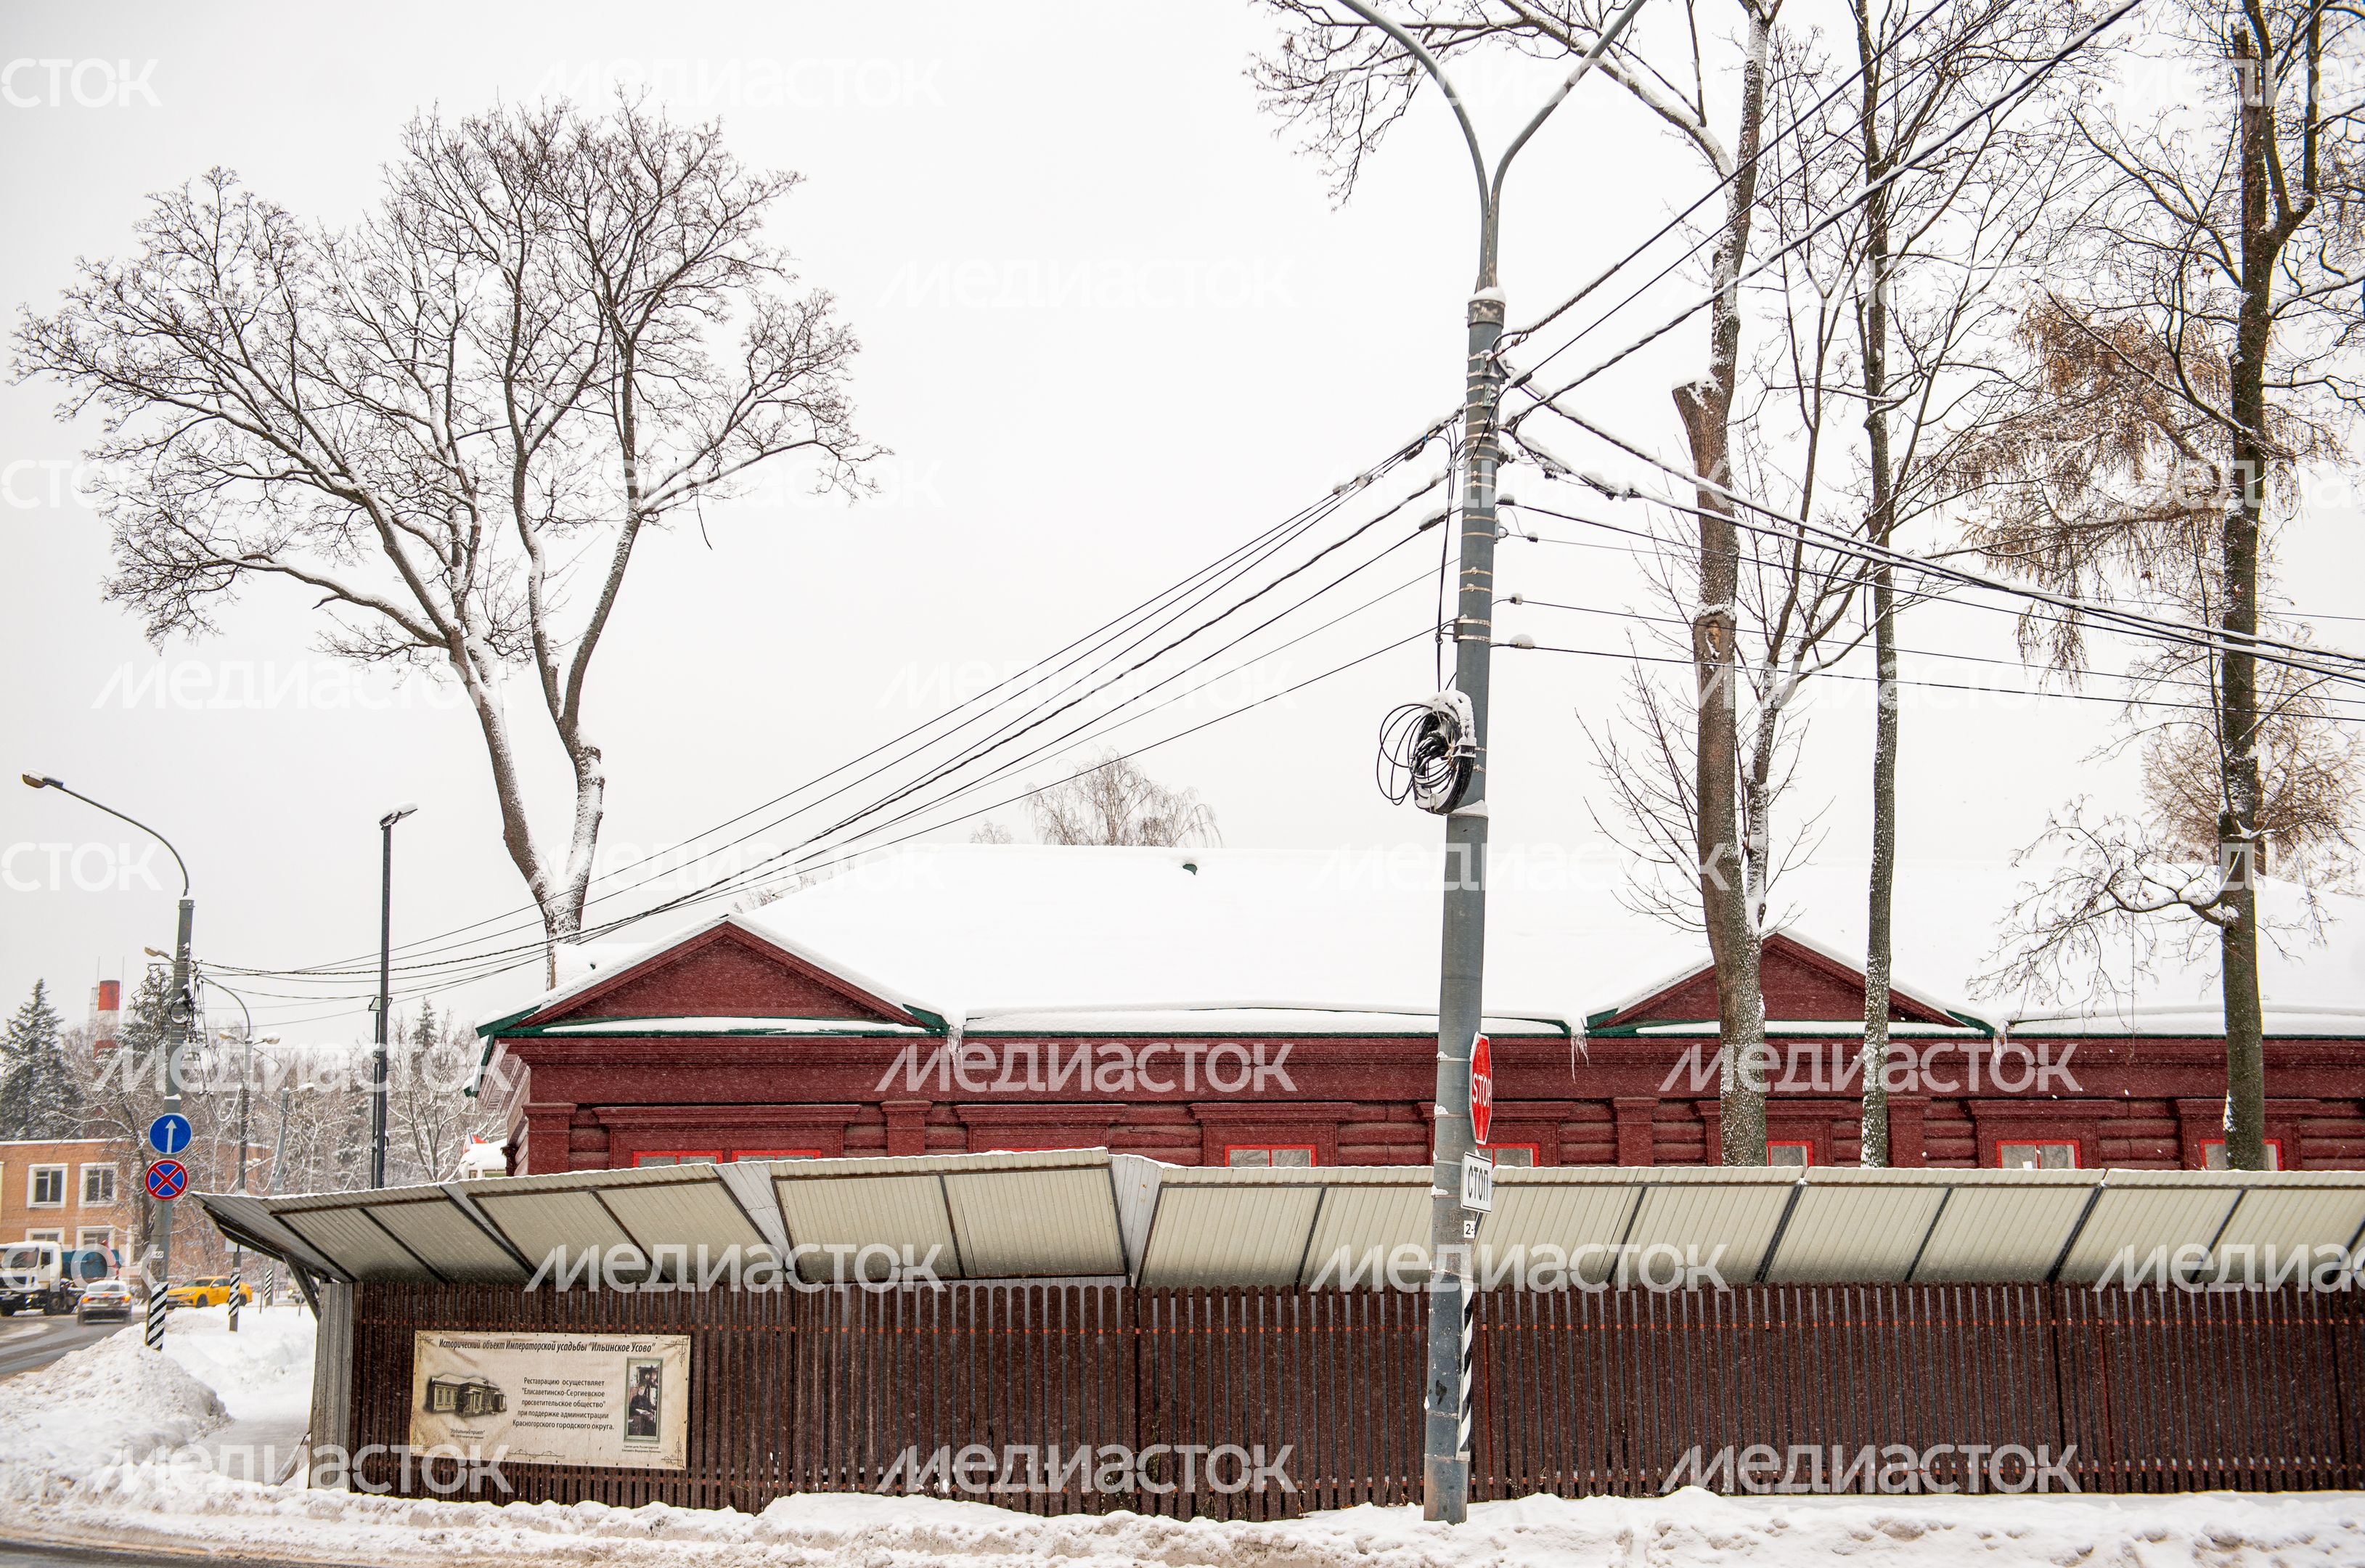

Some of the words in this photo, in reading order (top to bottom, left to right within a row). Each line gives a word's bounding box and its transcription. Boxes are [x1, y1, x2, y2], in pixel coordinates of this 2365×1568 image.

[1472, 1072, 1492, 1108] STOP
[1468, 1164, 1488, 1202] СТОП
[439, 1339, 481, 1351] Исторический
[482, 1340, 505, 1349] объект
[506, 1340, 556, 1352] Императорской
[556, 1342, 587, 1353] усадьбы
[523, 1377, 560, 1386] Реставрацию
[521, 1399, 572, 1408] просветительское
[560, 1411, 609, 1420] администрации
[512, 1419, 555, 1428] Красногорского
